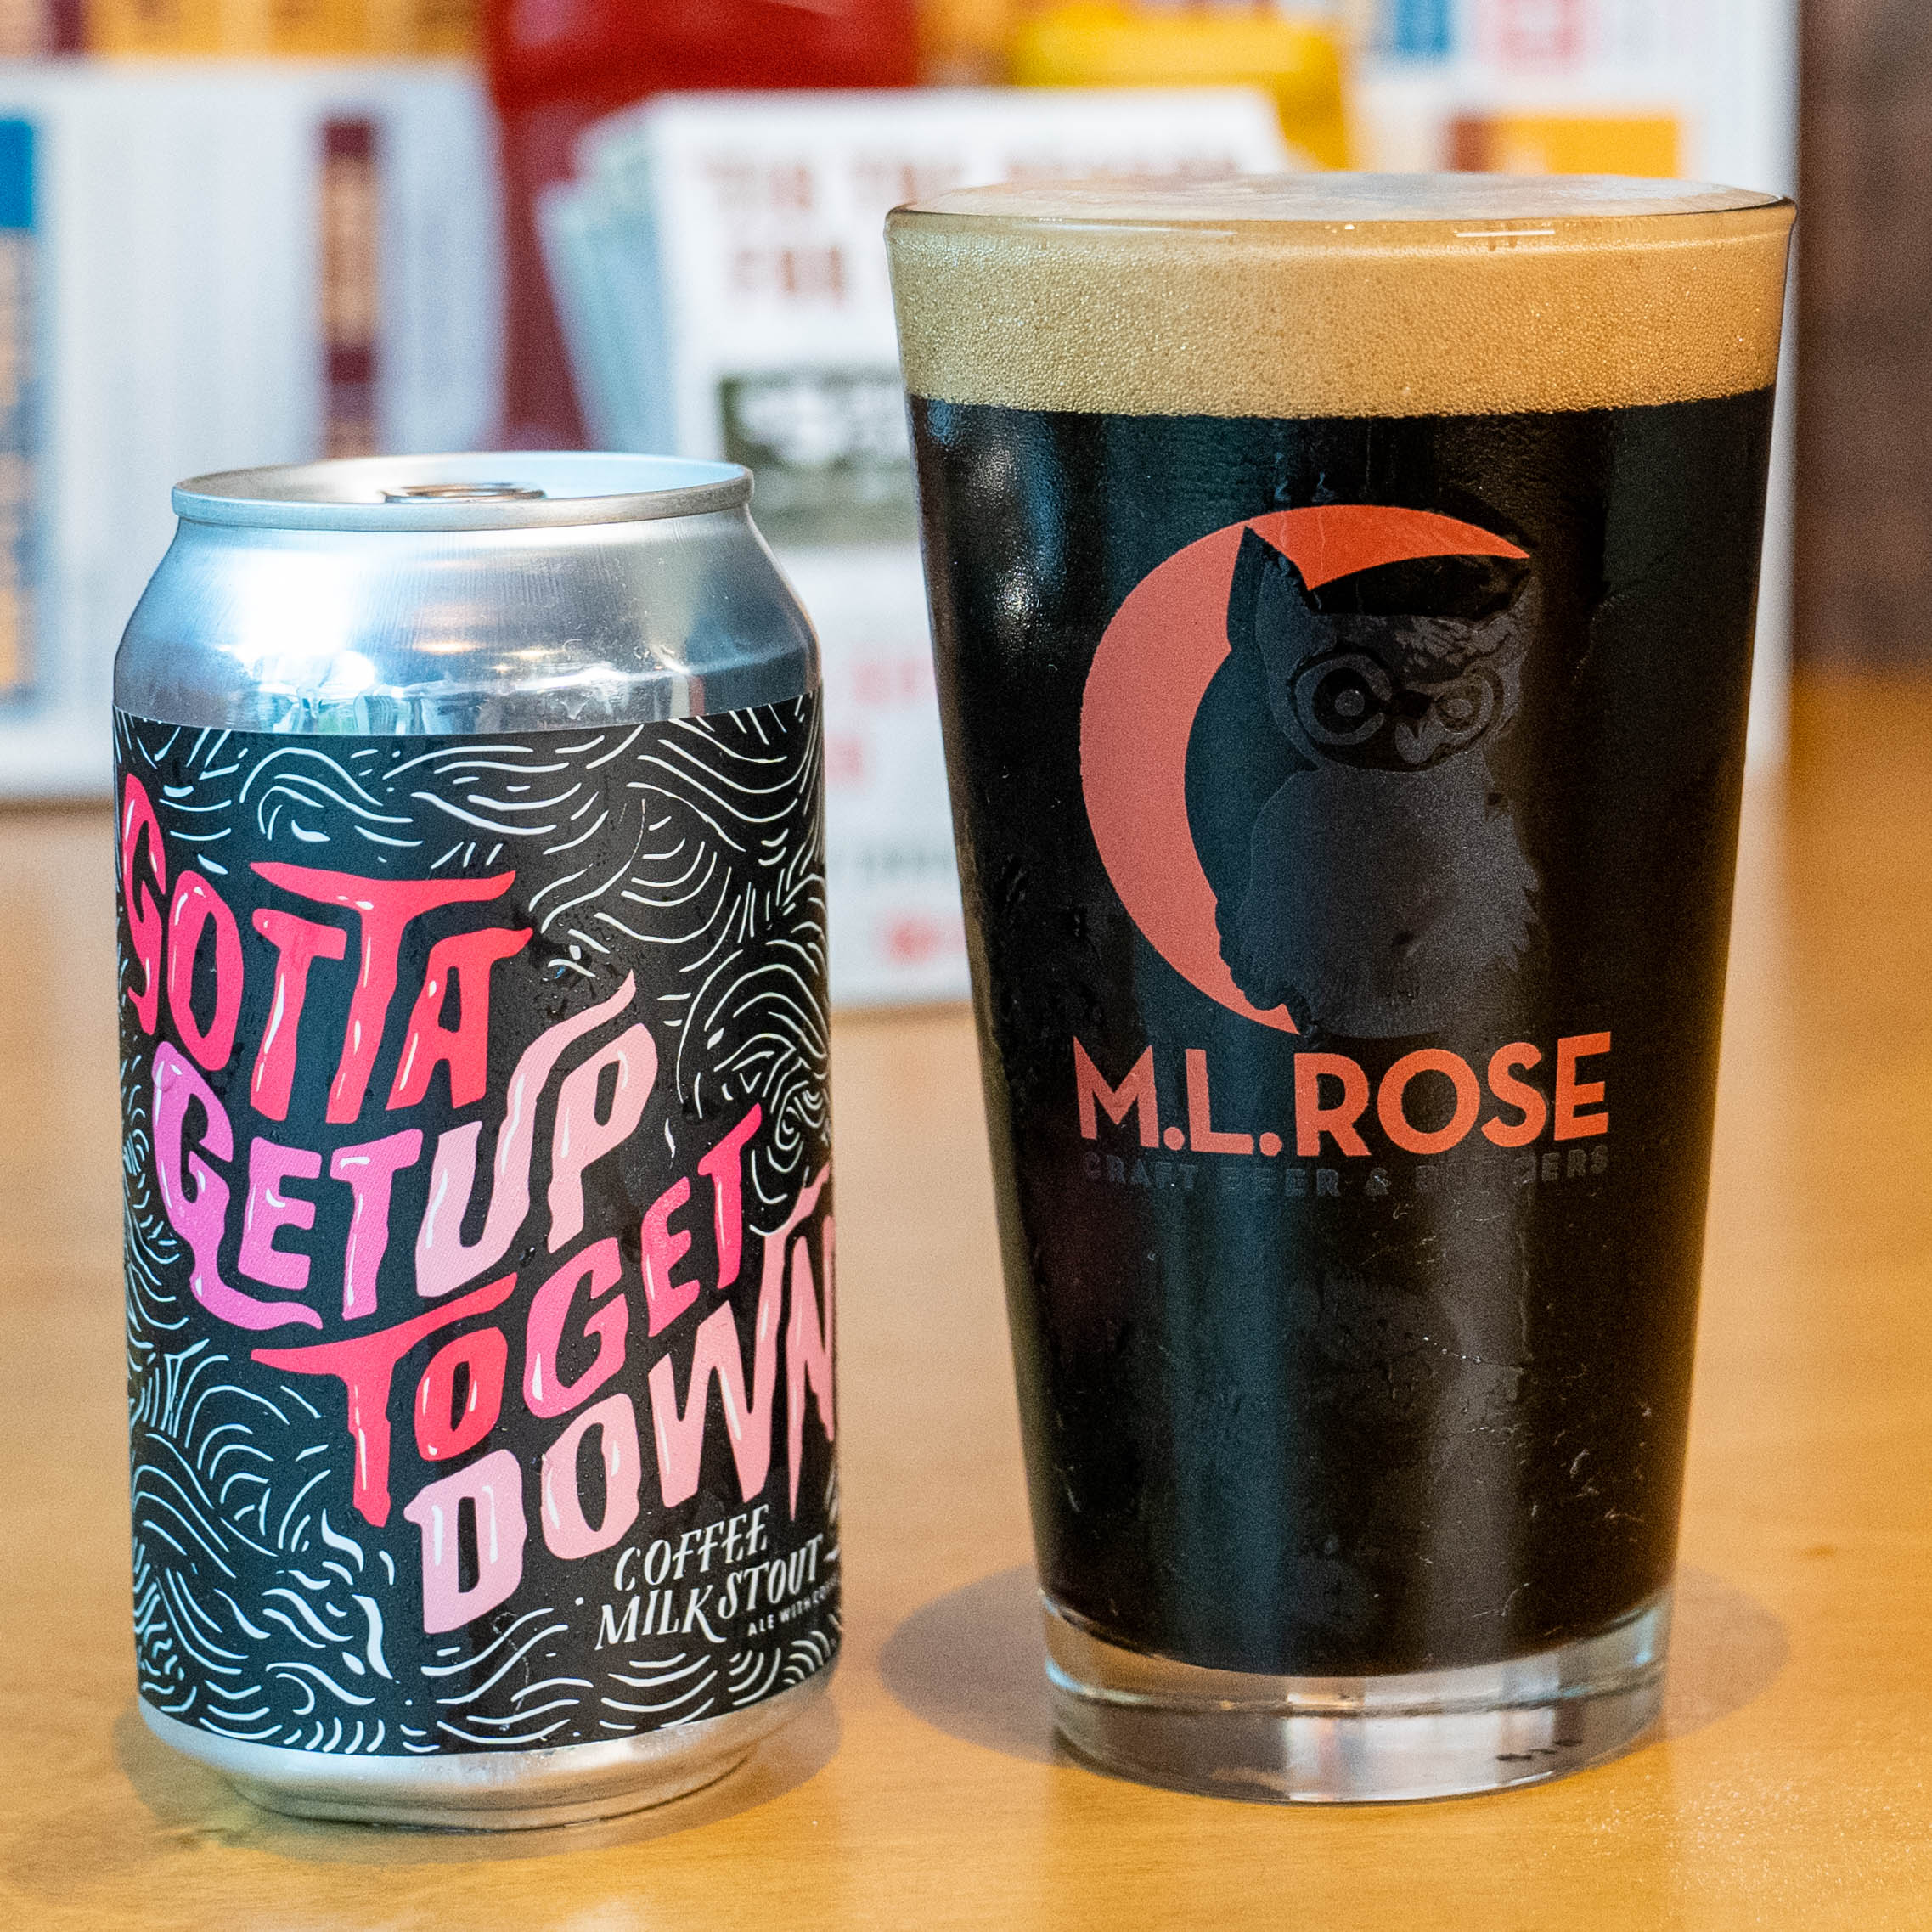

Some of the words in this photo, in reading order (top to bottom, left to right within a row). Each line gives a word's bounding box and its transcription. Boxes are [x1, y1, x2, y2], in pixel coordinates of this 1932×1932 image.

[123, 773, 532, 1123] GOTTA
[152, 1041, 422, 1331] GET
[415, 969, 658, 1298] UP
[1082, 1151, 1199, 1191] CRAFT
[251, 1272, 518, 1528] TO
[523, 1104, 762, 1418] GET
[403, 1163, 835, 1635] DOWN
[594, 1585, 727, 1651] MILK
[718, 1533, 823, 1619] STOUT
[613, 1504, 769, 1591] COFFEE
[747, 1614, 774, 1636] ALE
